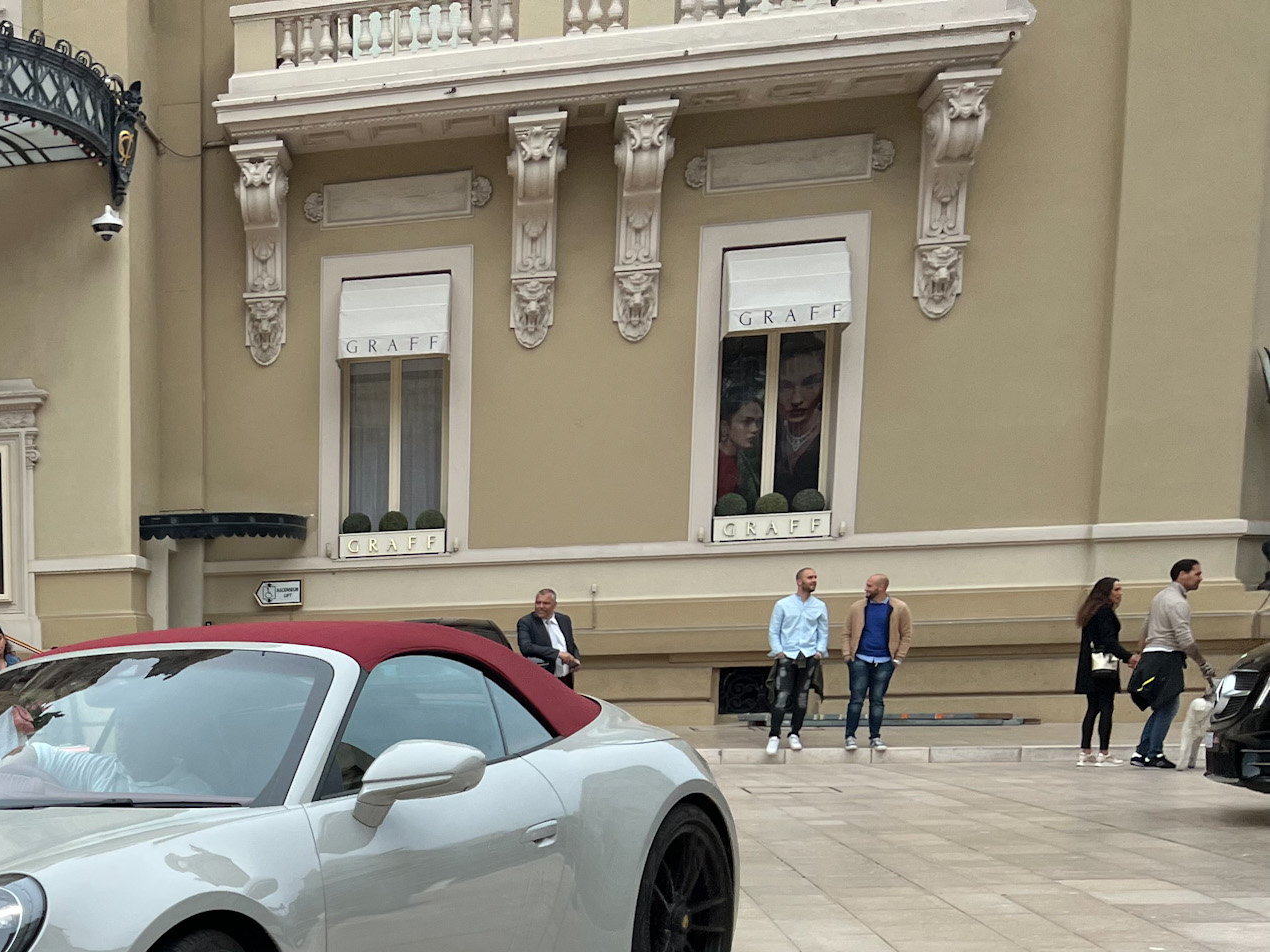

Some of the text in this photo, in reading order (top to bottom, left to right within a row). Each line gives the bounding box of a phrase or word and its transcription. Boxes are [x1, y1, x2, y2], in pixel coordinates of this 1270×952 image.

[739, 304, 842, 326] GRAFF
[346, 335, 438, 353] GRAFF
[723, 518, 820, 537] GRAFF
[347, 535, 436, 553] GRAFF
